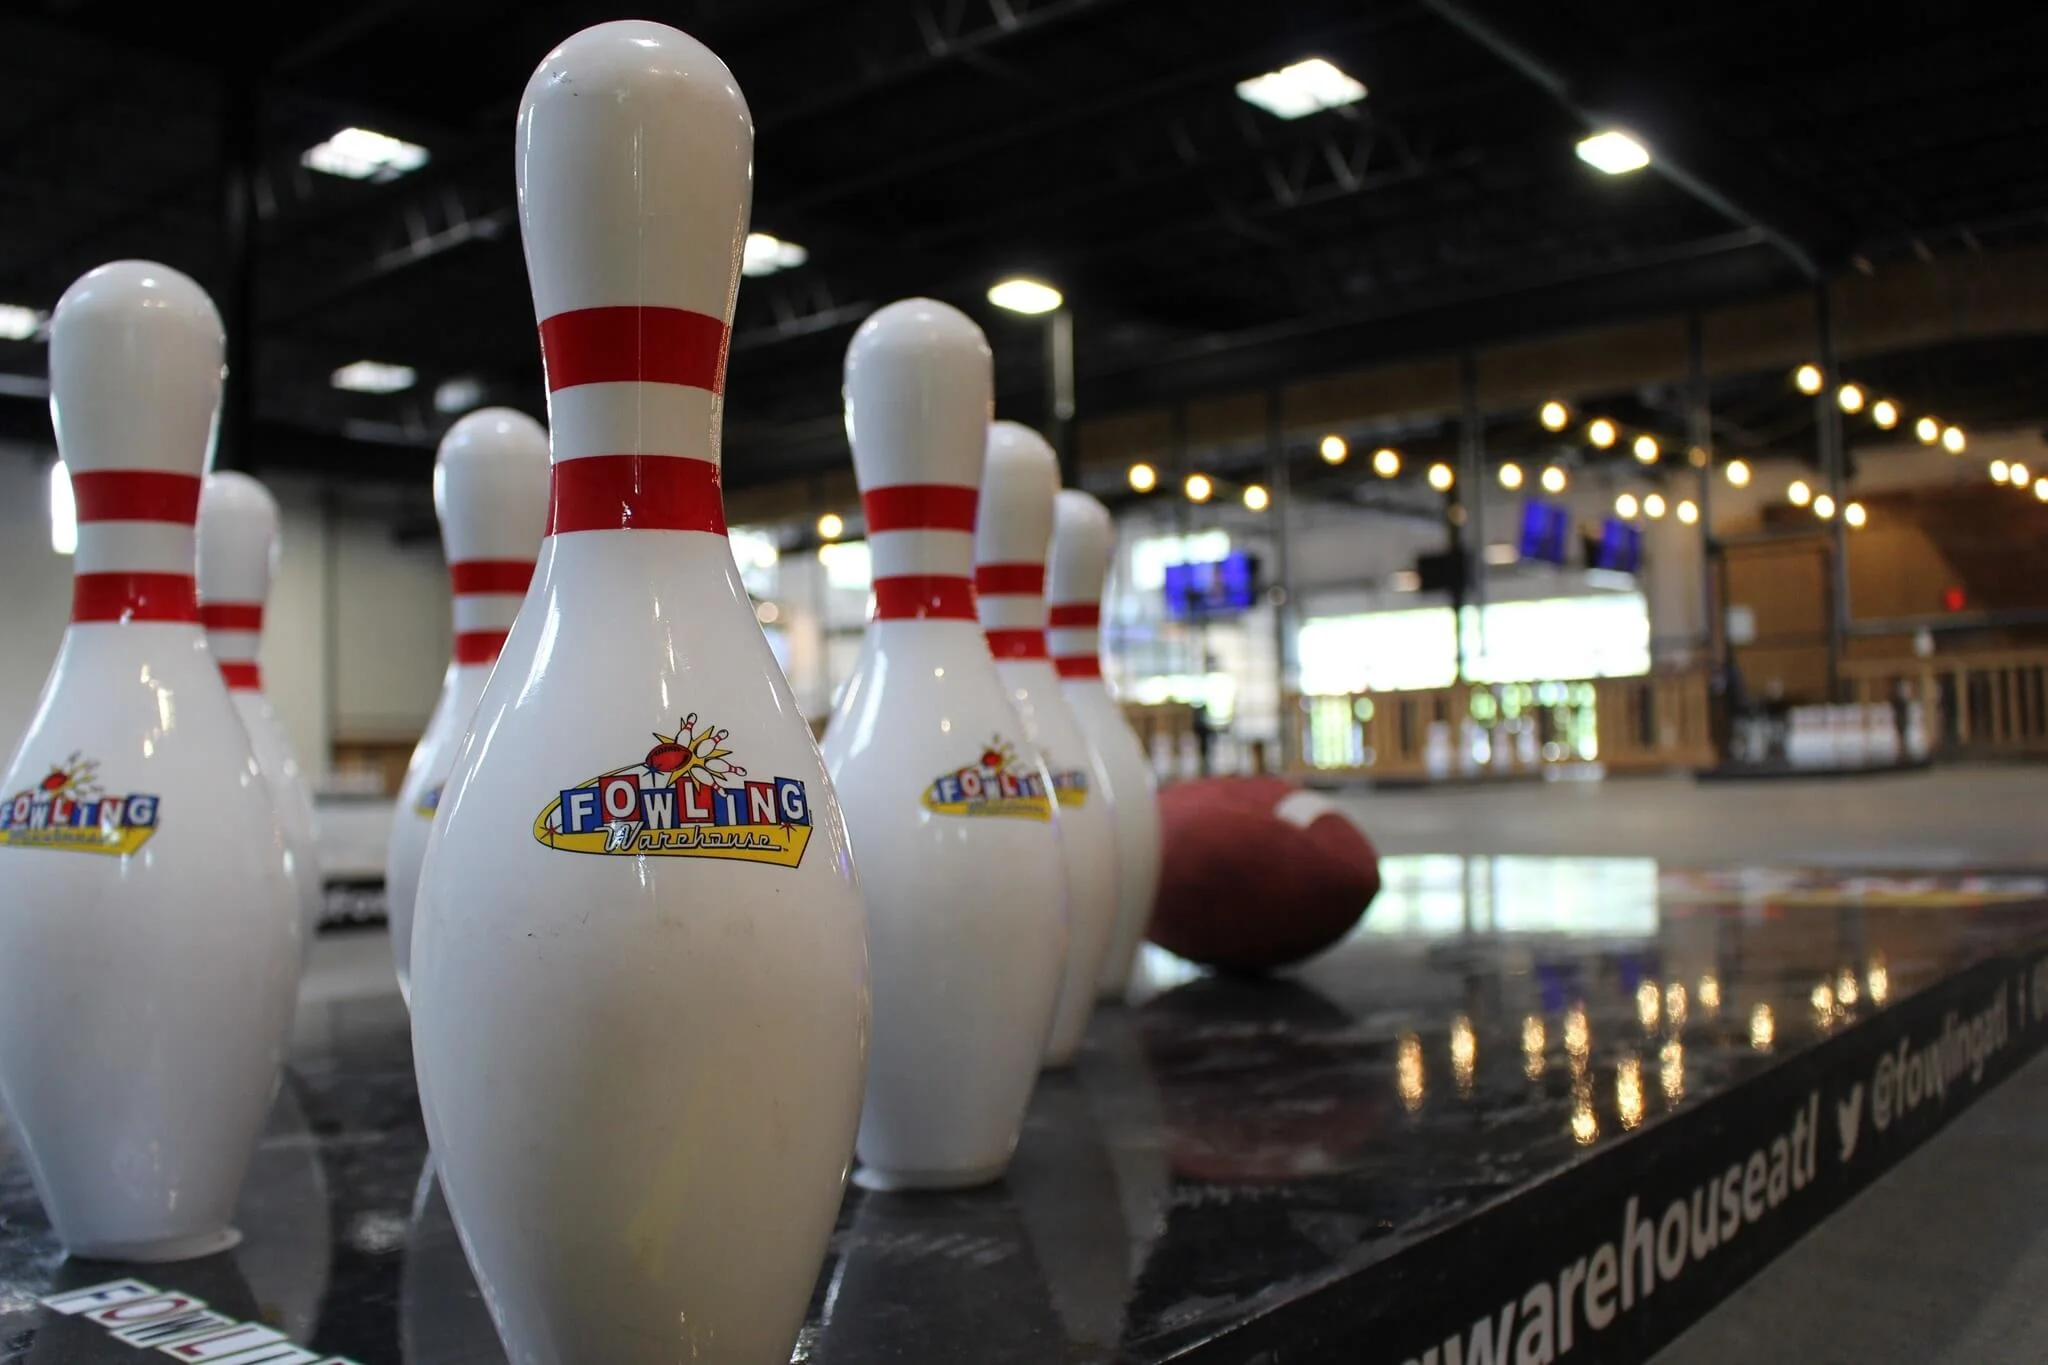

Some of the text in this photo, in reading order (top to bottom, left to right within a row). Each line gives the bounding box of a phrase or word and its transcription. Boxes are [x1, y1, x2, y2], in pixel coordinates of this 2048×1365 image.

[570, 779, 804, 832] FOWLING
[594, 820, 782, 853] Warehouse
[1402, 1090, 1819, 1365] warehouseatl
